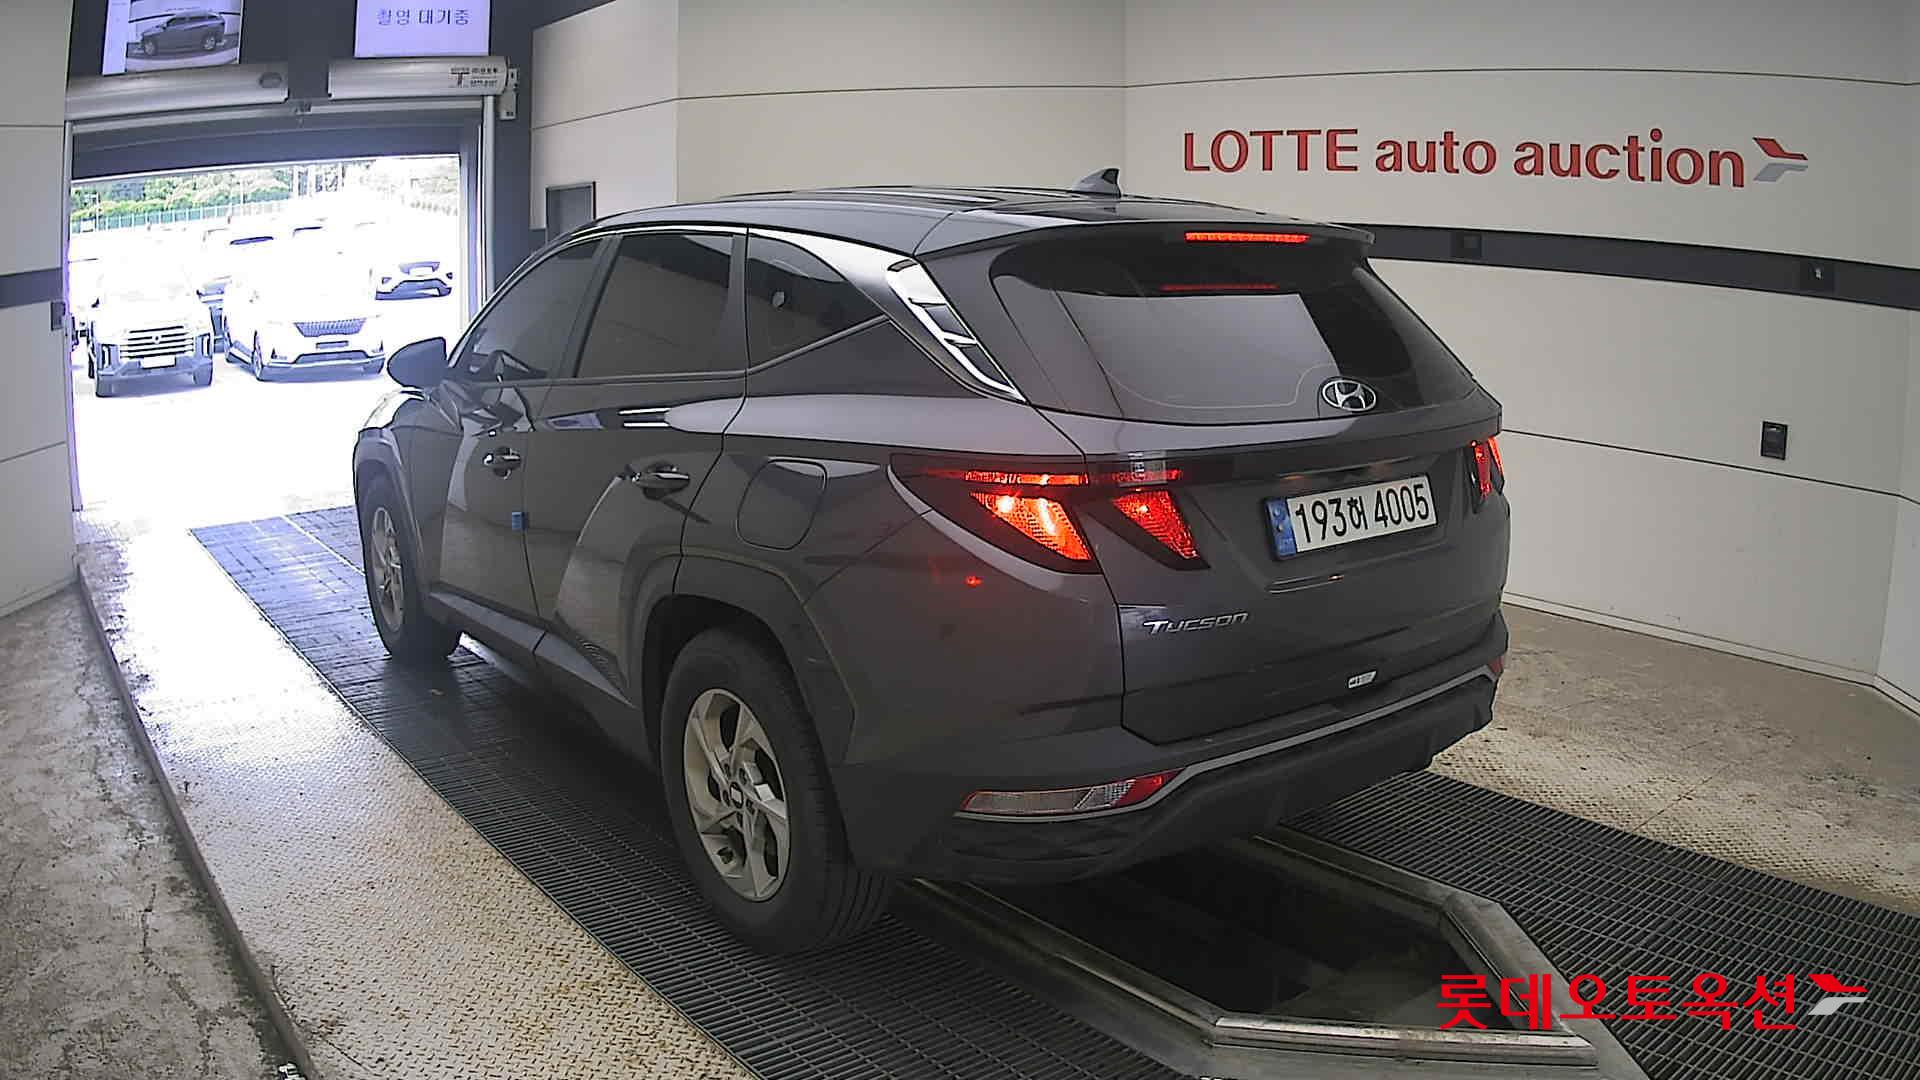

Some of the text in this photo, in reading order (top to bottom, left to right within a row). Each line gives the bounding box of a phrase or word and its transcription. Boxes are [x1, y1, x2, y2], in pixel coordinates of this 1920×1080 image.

[418, 8, 469, 26] 대기중
[1184, 128, 1745, 188] LOTTE auto auction
[1296, 483, 1430, 544] 193허 4005
